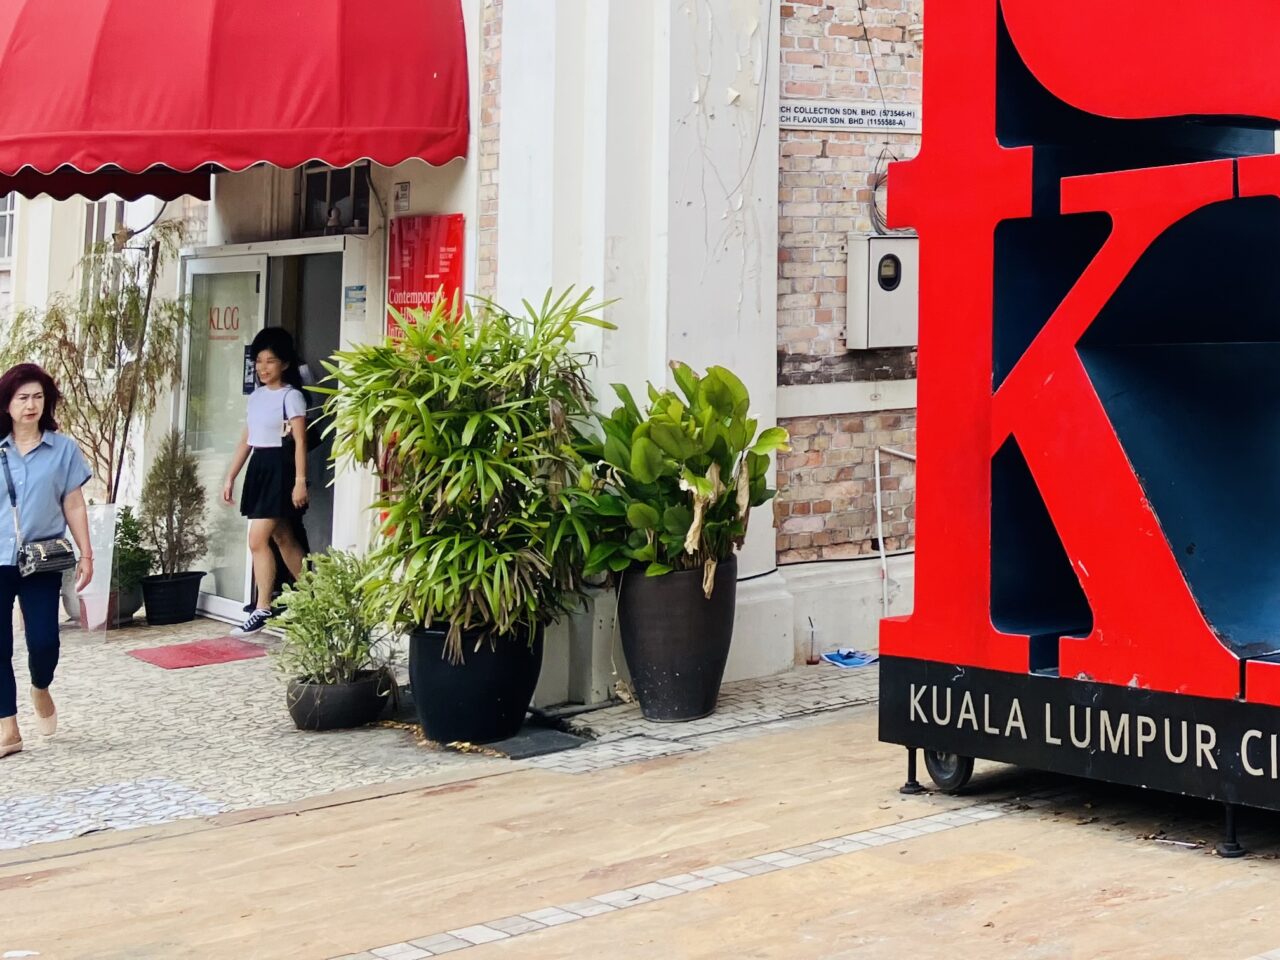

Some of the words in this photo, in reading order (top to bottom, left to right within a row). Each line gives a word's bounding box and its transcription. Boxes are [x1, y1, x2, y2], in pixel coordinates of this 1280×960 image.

[793, 106, 840, 115] COLLECTION
[779, 115, 791, 123] CH
[388, 289, 446, 307] Contempora
[909, 683, 1028, 740] KUALA
[1045, 703, 1218, 771] LUMPUR
